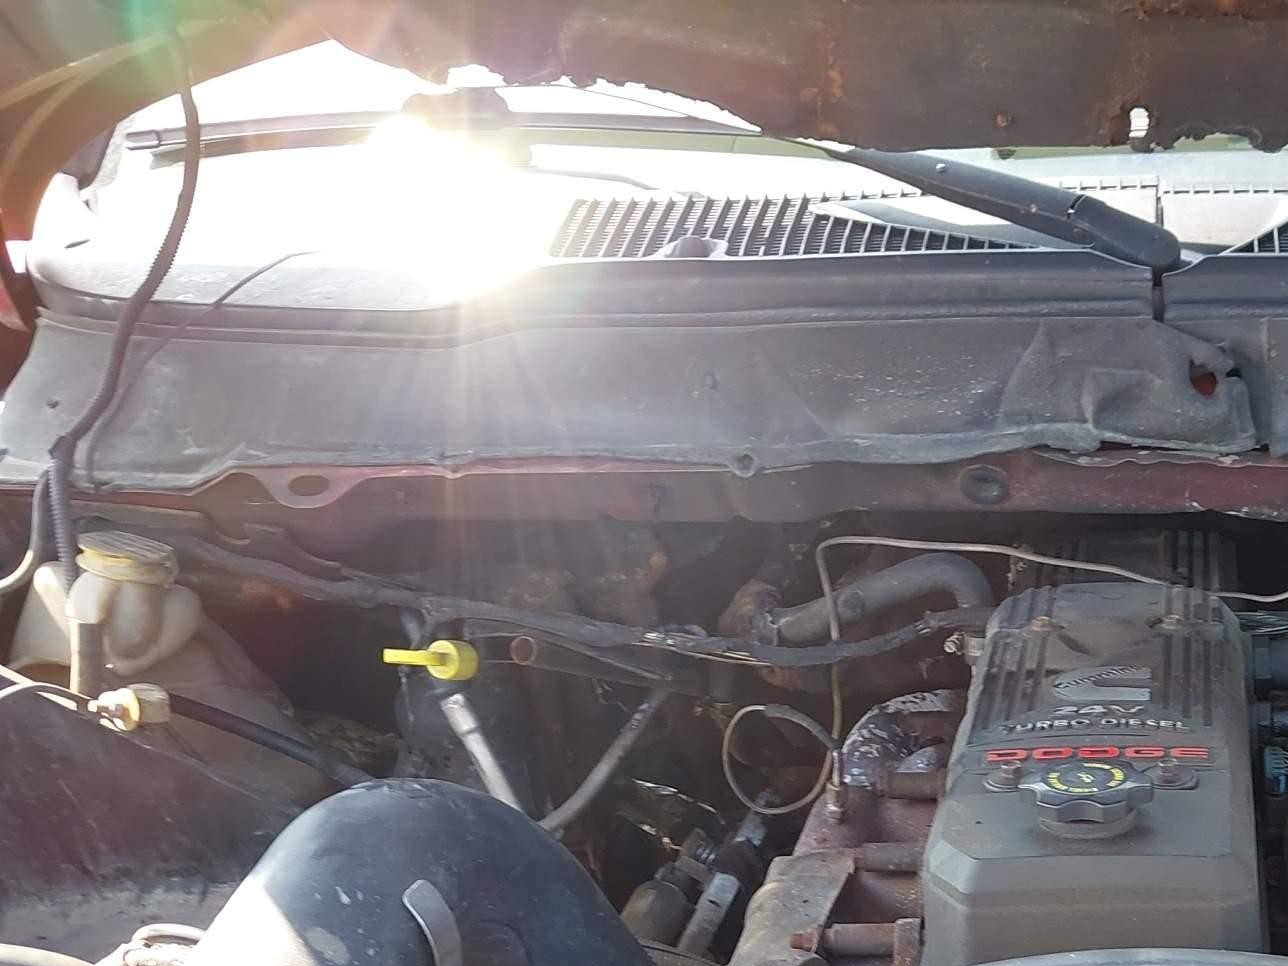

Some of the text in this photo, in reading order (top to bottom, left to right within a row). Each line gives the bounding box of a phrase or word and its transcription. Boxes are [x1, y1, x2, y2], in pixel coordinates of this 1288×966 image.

[1053, 704, 1145, 716] 24V
[1101, 717, 1191, 733] DIESEL
[986, 744, 1211, 762] DODGE
